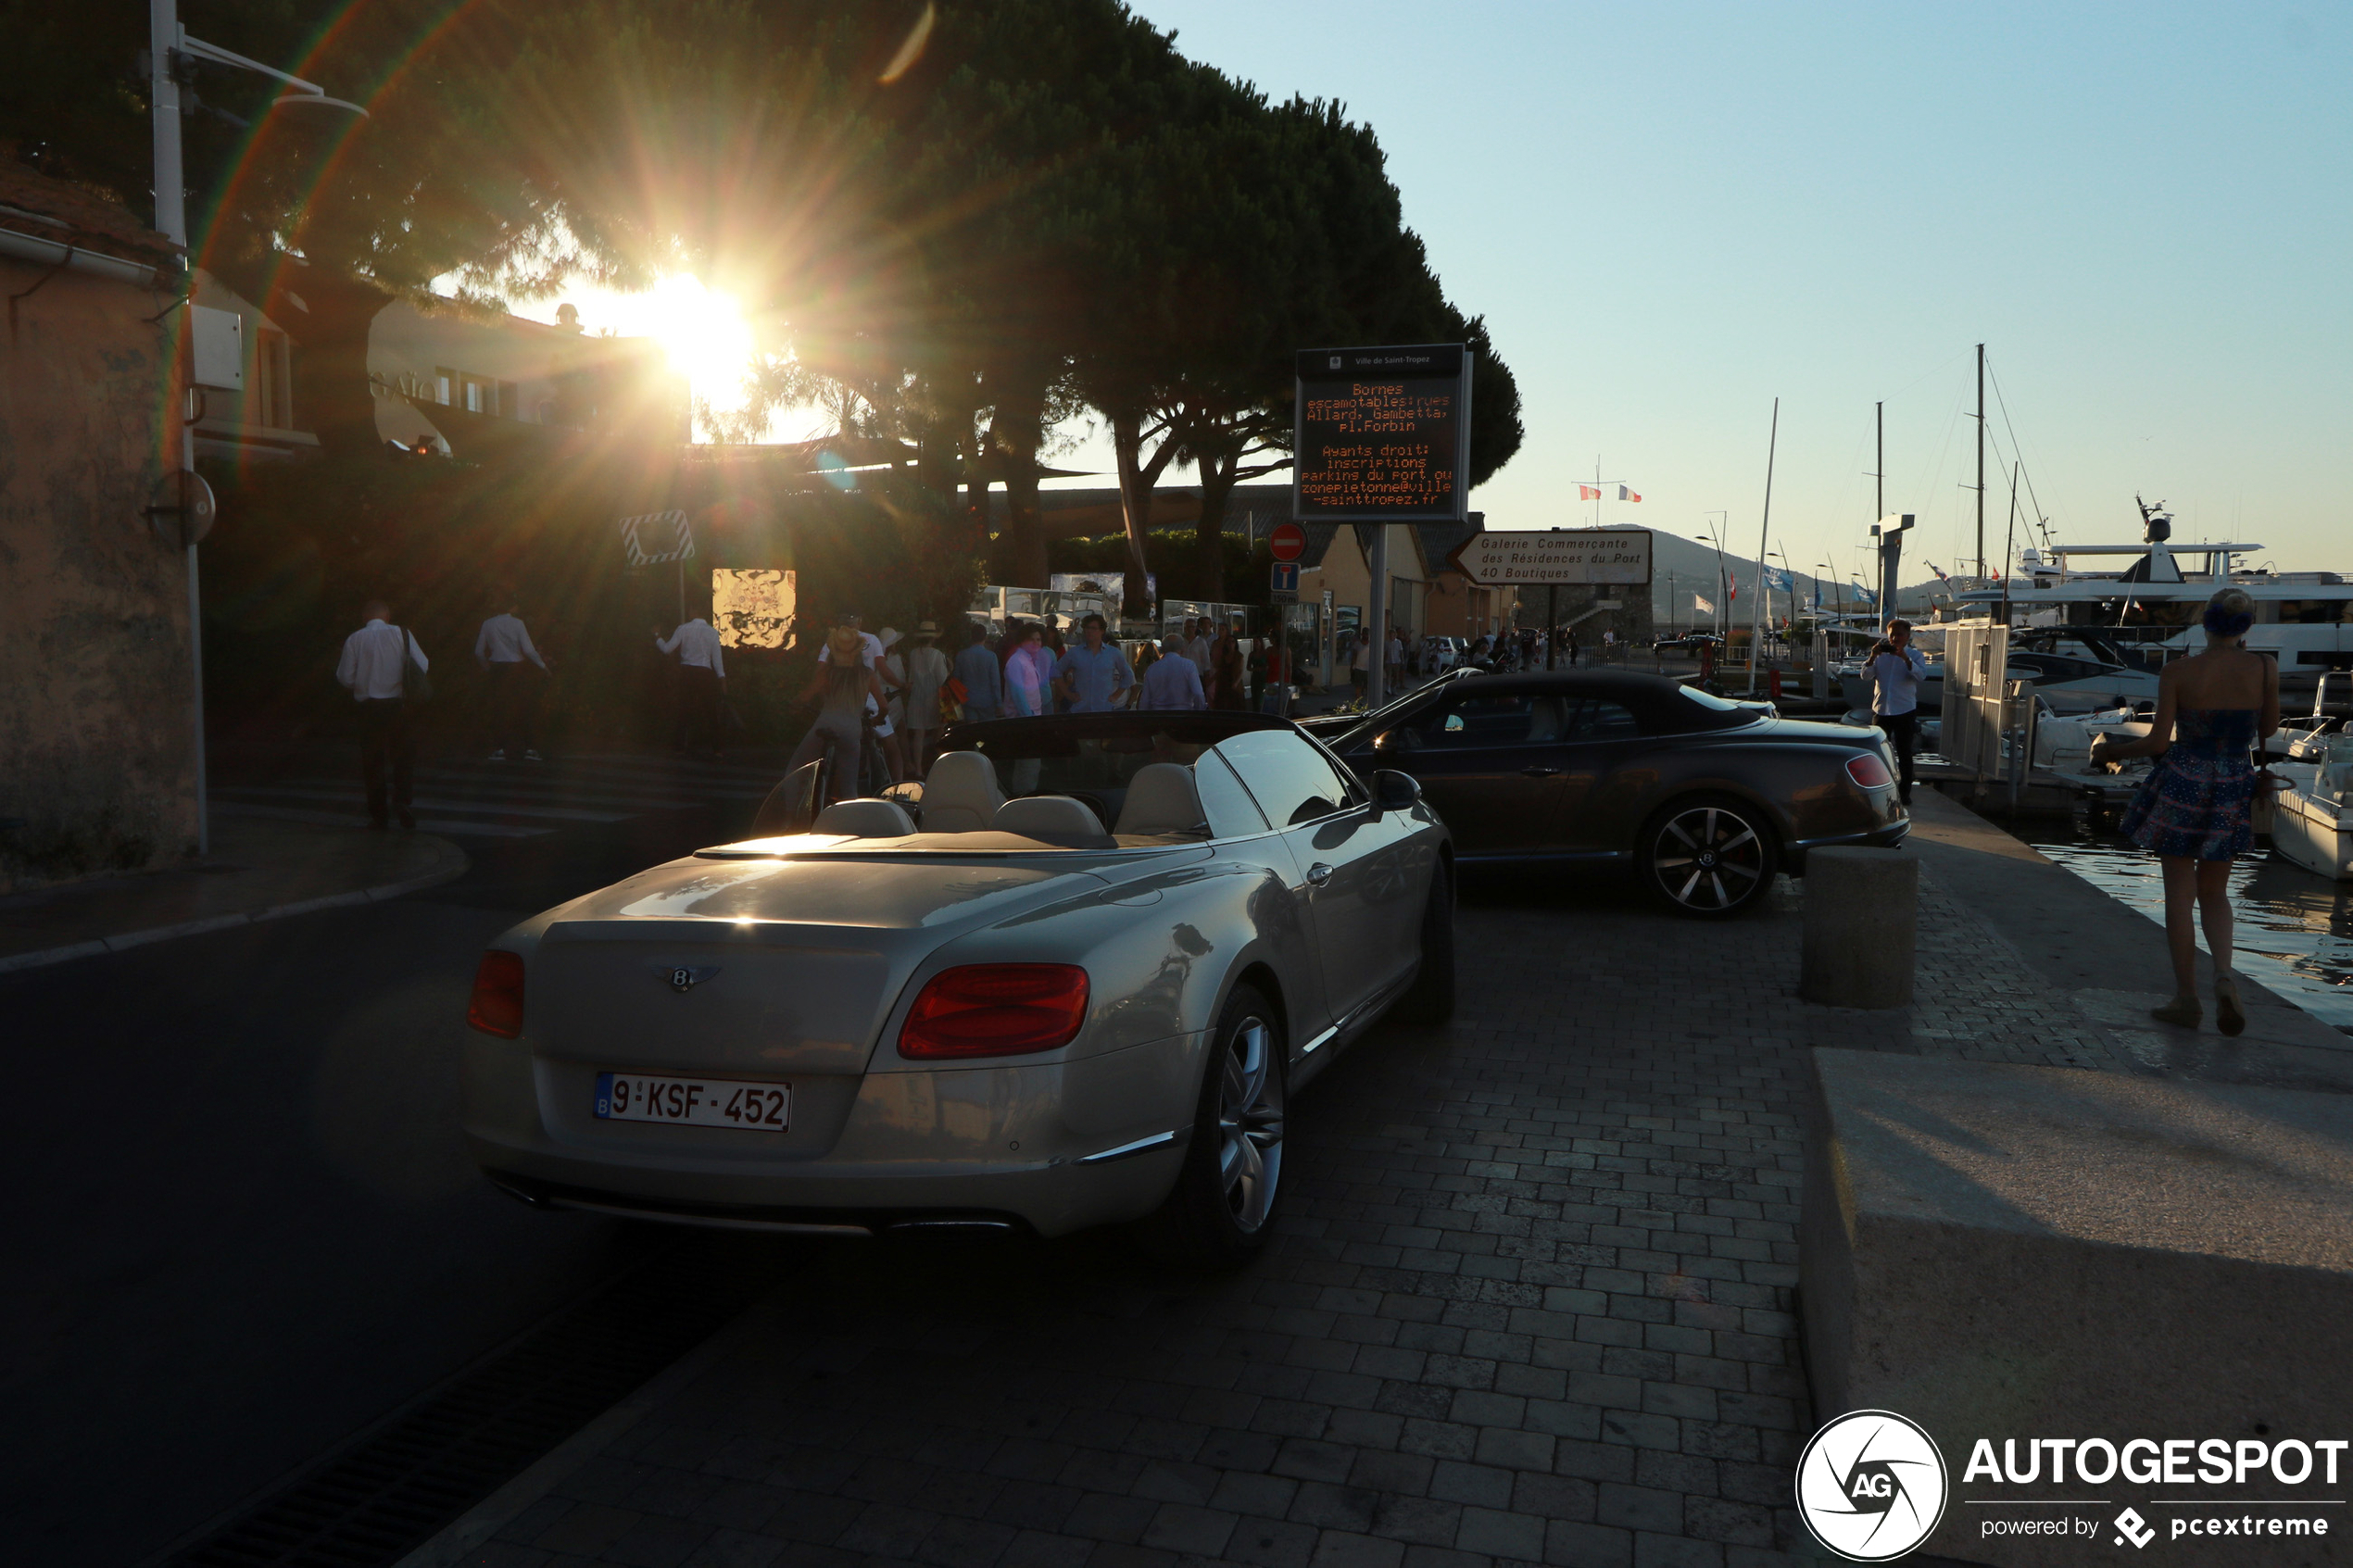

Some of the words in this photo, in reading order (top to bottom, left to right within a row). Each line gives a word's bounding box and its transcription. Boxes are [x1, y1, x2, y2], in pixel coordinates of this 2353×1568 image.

[1355, 357, 1372, 365] Ville
[1384, 356, 1429, 365] Saint-Tropez
[1353, 383, 1403, 396] Bornes
[1307, 408, 1363, 421] Allard,
[1373, 408, 1447, 420] Gambetta,
[1340, 420, 1416, 433] pl.Forbin
[1322, 445, 1372, 458] Ayants
[1380, 444, 1429, 457] droit:
[1327, 457, 1427, 469] inscriptions
[1302, 470, 1359, 482] parking
[1367, 470, 1384, 481] du
[1392, 470, 1427, 481] port
[1434, 470, 1453, 480] ou
[1302, 481, 1452, 494] zonepietonne@ville
[1313, 494, 1439, 506] -sainttropez.fr
[1481, 538, 1529, 549] Galerie
[1538, 538, 1629, 550] Commerçante
[1482, 553, 1504, 563] des
[1511, 552, 1583, 564] Résidences
[1592, 552, 1606, 563] du
[1614, 553, 1641, 564] Port
[1480, 568, 1498, 578] 40
[1505, 568, 1569, 581] Boutiques
